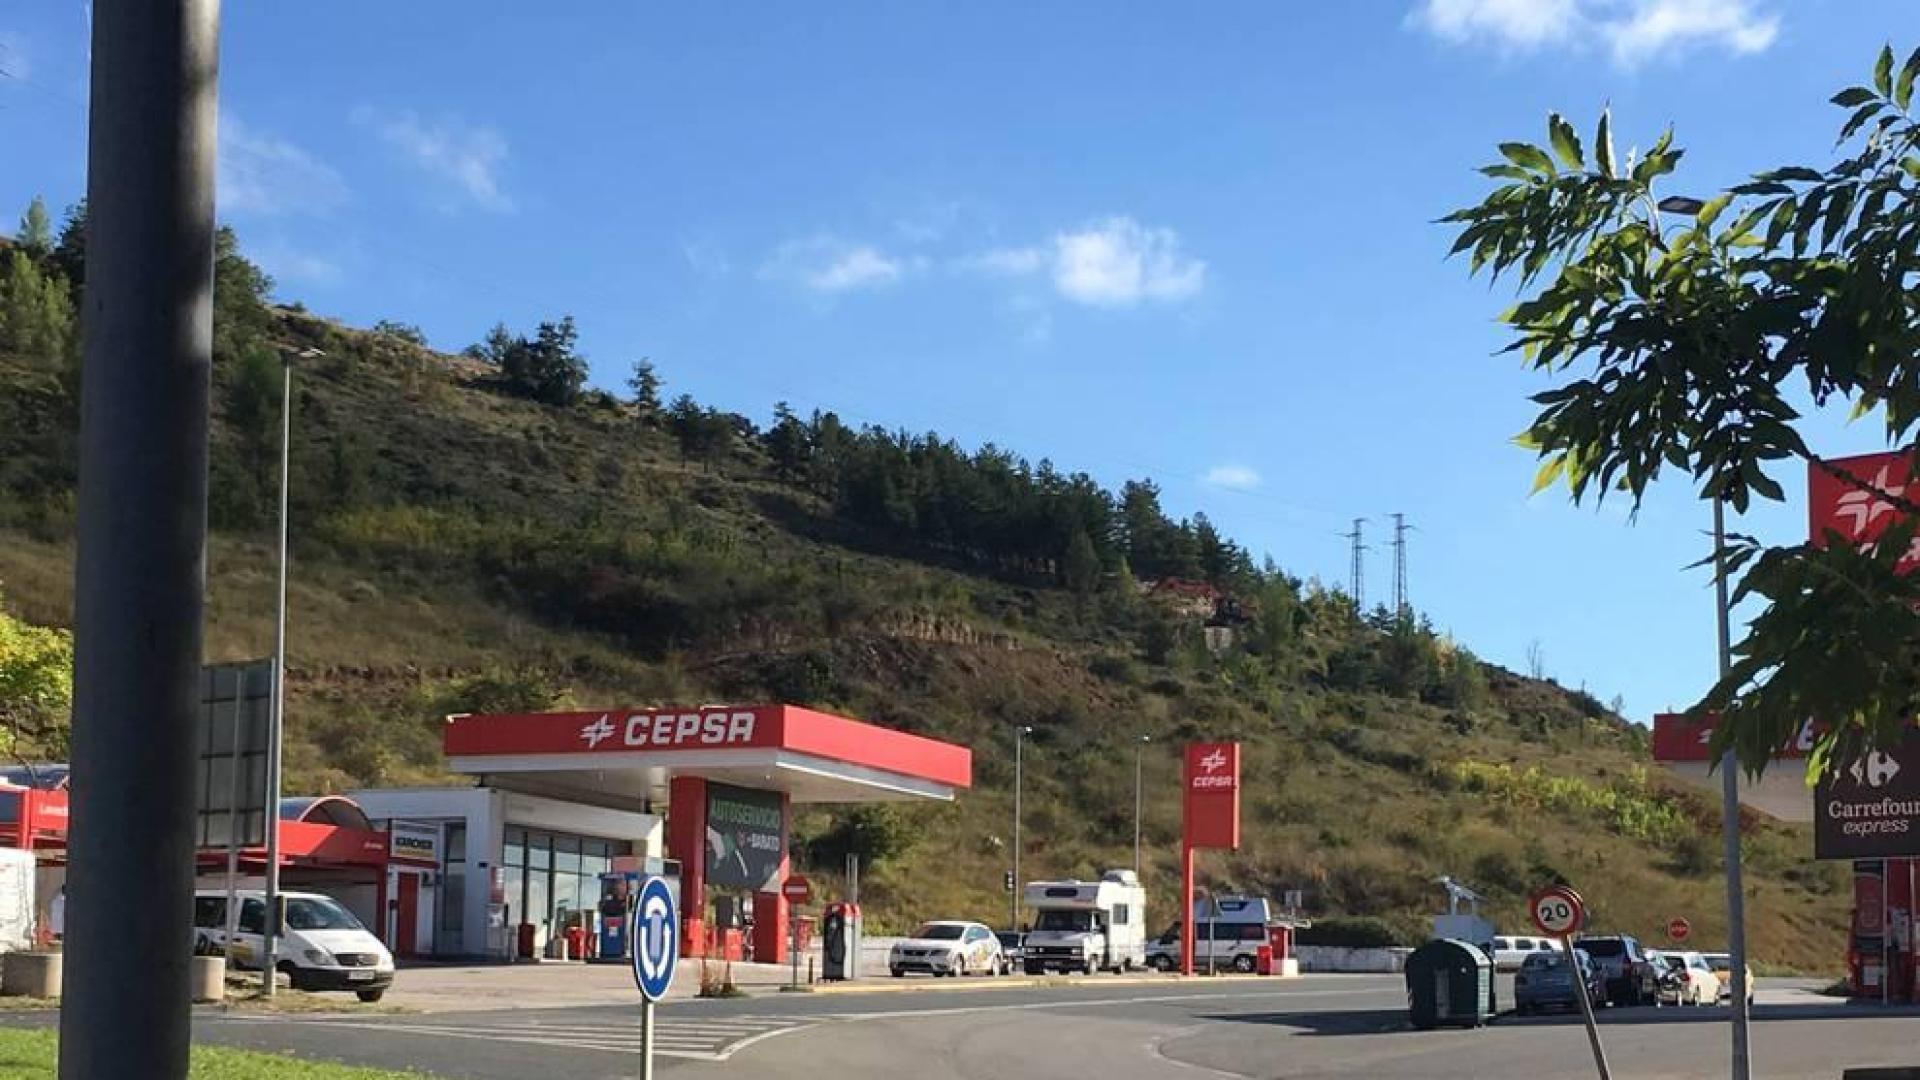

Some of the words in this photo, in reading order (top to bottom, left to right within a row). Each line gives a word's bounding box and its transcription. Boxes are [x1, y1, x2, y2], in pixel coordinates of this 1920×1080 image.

[624, 712, 755, 746] CEPSA
[1192, 775, 1233, 788] CEPSA
[1843, 819, 1909, 837] express
[1540, 902, 1570, 922] 20
